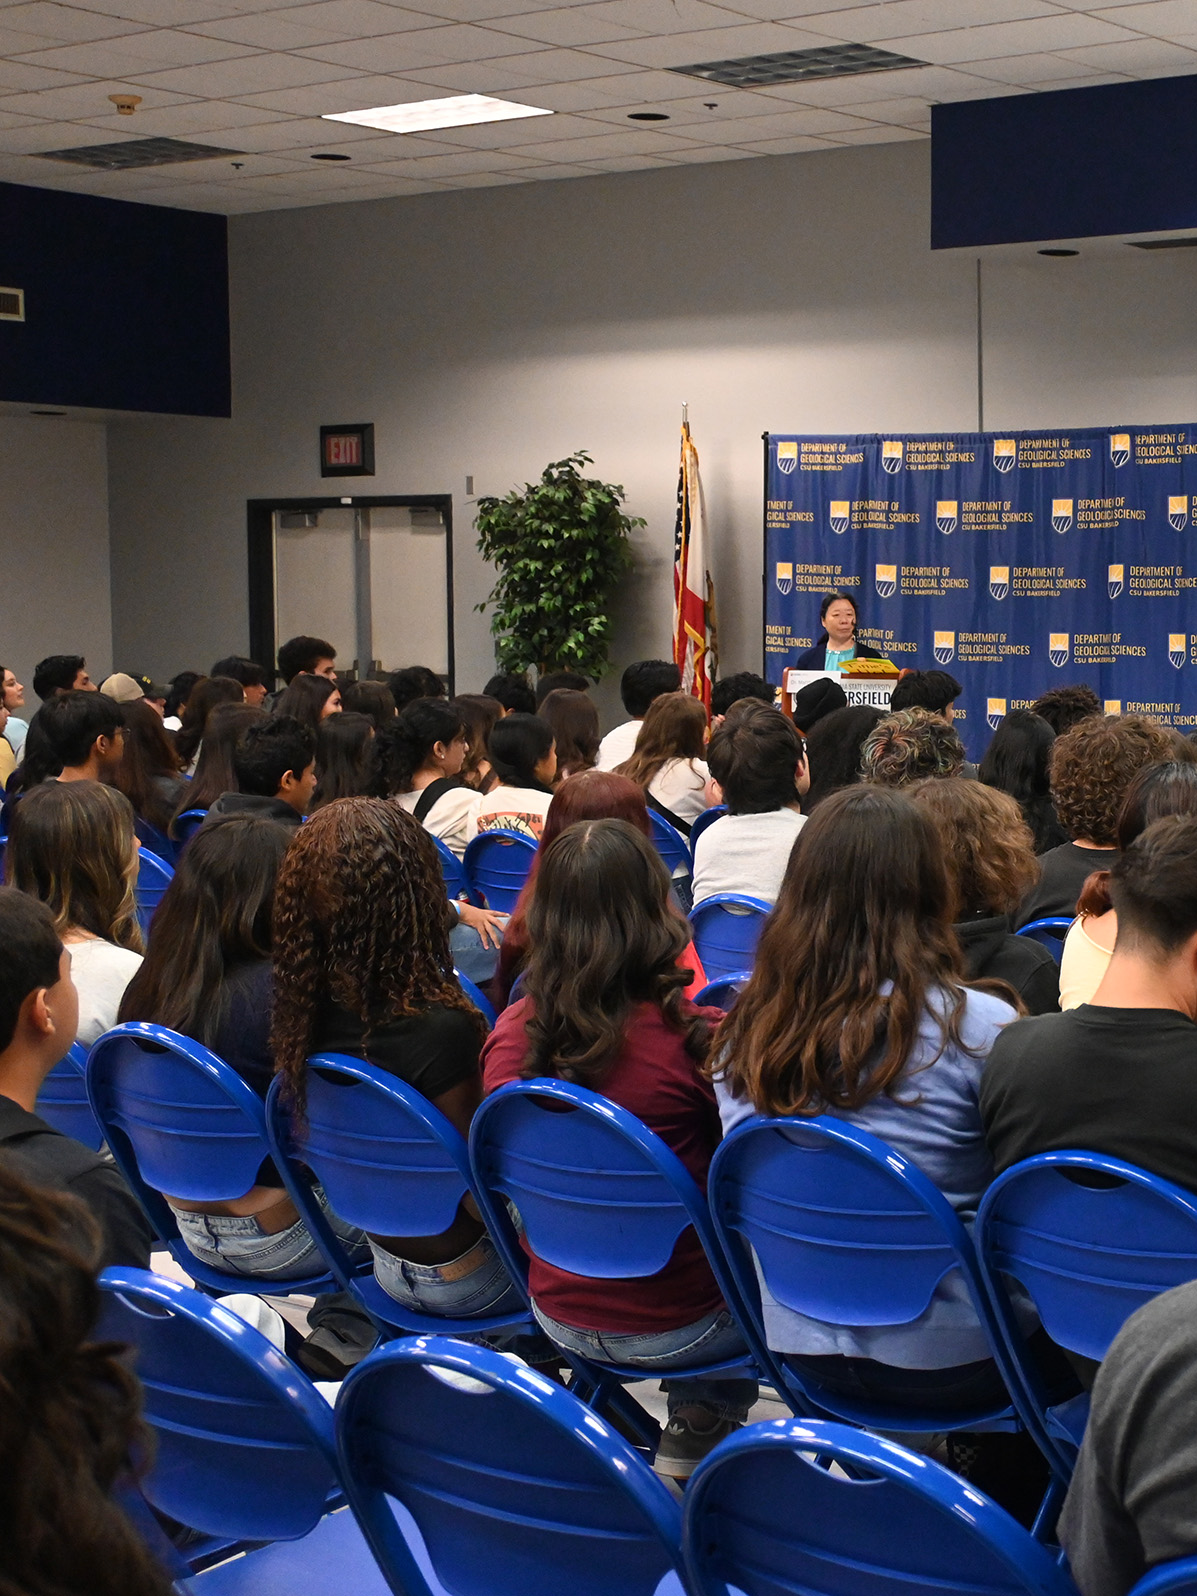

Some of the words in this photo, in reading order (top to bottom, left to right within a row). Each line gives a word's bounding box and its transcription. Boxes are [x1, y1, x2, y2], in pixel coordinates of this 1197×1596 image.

[1062, 438, 1070, 447] OF
[1135, 434, 1176, 444] EPARTMENT
[1178, 433, 1185, 442] OF
[331, 437, 358, 464] EXIT
[839, 443, 846, 452] OF
[947, 442, 954, 450] OF
[1135, 446, 1174, 456] EOLOGCAL
[801, 454, 835, 463] GEOLOGCAL
[945, 453, 974, 462] SCIENCES
[1019, 450, 1057, 460] GEOLGICAL
[1059, 449, 1091, 459] SCIENCES
[891, 502, 899, 511] OF
[1004, 501, 1011, 511] OF
[1078, 498, 1114, 509] DEPARTME
[1115, 497, 1125, 507] OF
[851, 512, 886, 522] GEOLOICAL
[1002, 513, 1033, 522] SCIENCES
[835, 566, 842, 575] OF
[942, 567, 950, 576] OF
[1057, 567, 1064, 577] OF
[1130, 566, 1174, 576] DEPARTMENT
[1176, 566, 1183, 576] OF
[901, 578, 938, 587] GEOLOGCAL
[940, 579, 968, 588] SCIENCES
[1056, 579, 1086, 588] SCIENCES
[1130, 578, 1172, 588] GEOLOGICAL
[885, 630, 894, 639] OF
[959, 633, 999, 642] DEPARTMENT
[1000, 634, 1007, 643] OF
[1113, 633, 1121, 643] OF
[883, 641, 917, 652] SCIENCES
[958, 644, 997, 654] GEOLOGICAL
[999, 645, 1030, 655] SCIENCES
[1111, 645, 1146, 656] SCIENCES
[1011, 700, 1037, 709] DEPAR
[1127, 702, 1173, 713] DEPARTMENT
[1174, 704, 1180, 713] OF
